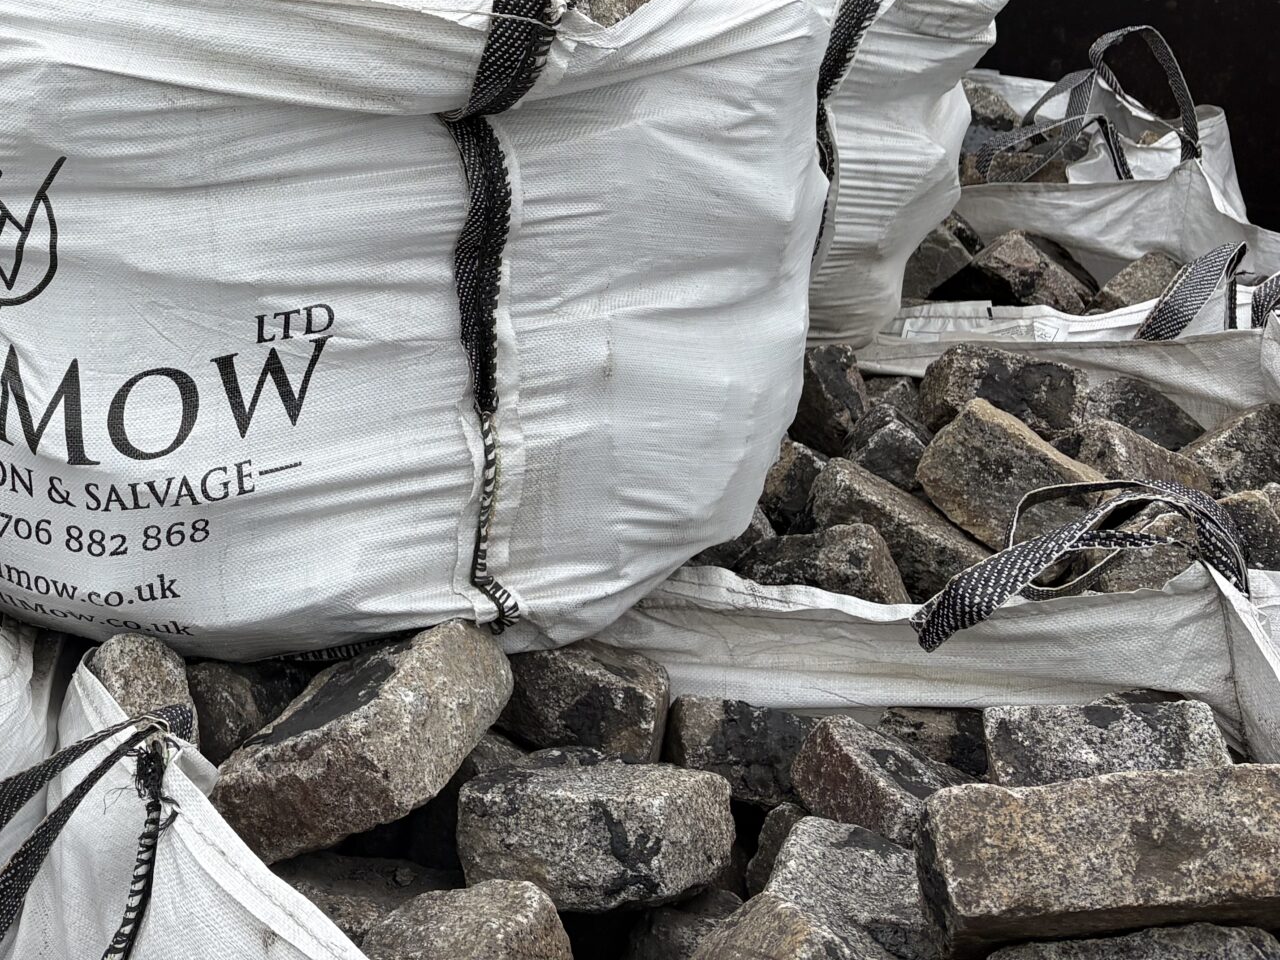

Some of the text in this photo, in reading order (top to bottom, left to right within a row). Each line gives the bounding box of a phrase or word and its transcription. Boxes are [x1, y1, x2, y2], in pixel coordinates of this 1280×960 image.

[254, 303, 335, 344] LTD
[47, 476, 77, 508] &
[84, 459, 256, 513] SALVAGE
[65, 525, 129, 557] 882
[142, 518, 210, 551] 868
